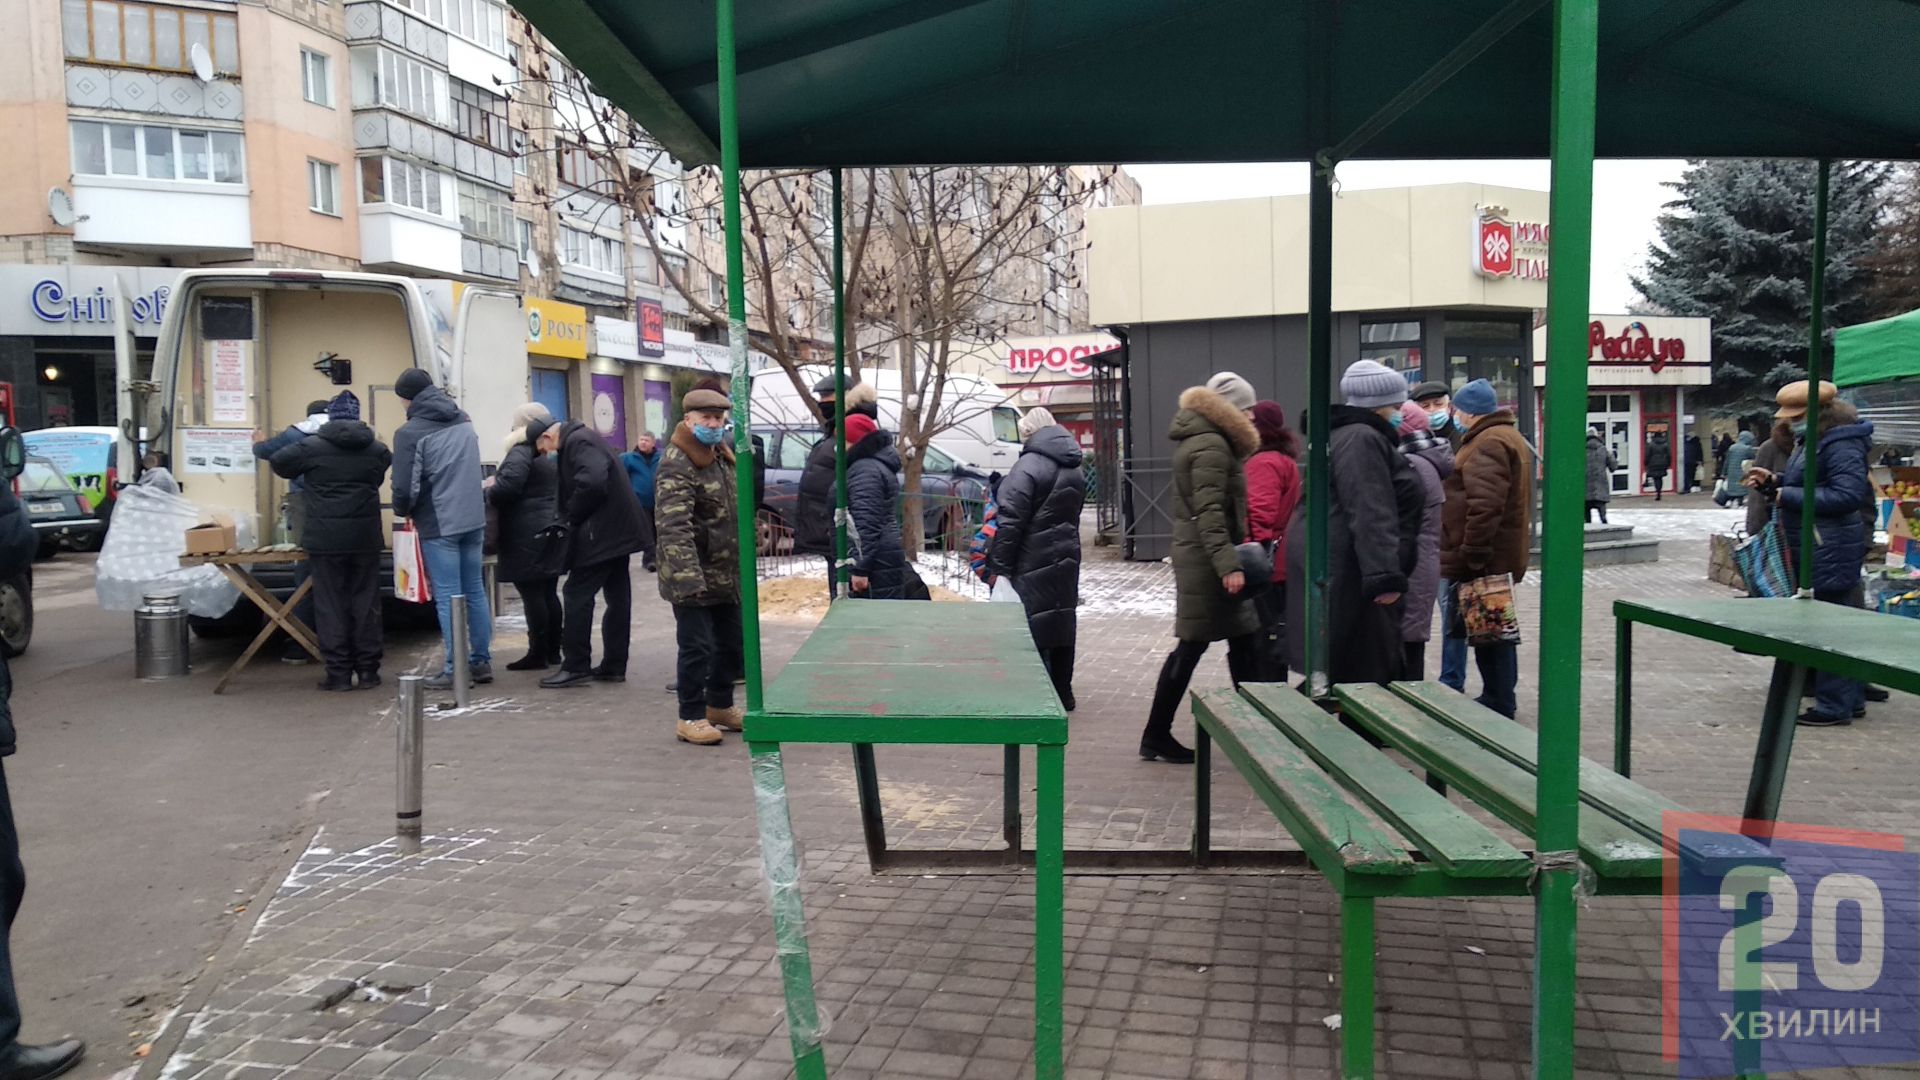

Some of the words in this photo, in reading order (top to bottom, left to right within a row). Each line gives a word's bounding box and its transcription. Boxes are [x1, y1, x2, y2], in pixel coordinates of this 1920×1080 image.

[1516, 222, 1549, 241] М'ЯС
[1516, 258, 1548, 279] ГІЛЬ
[547, 319, 583, 340] POST
